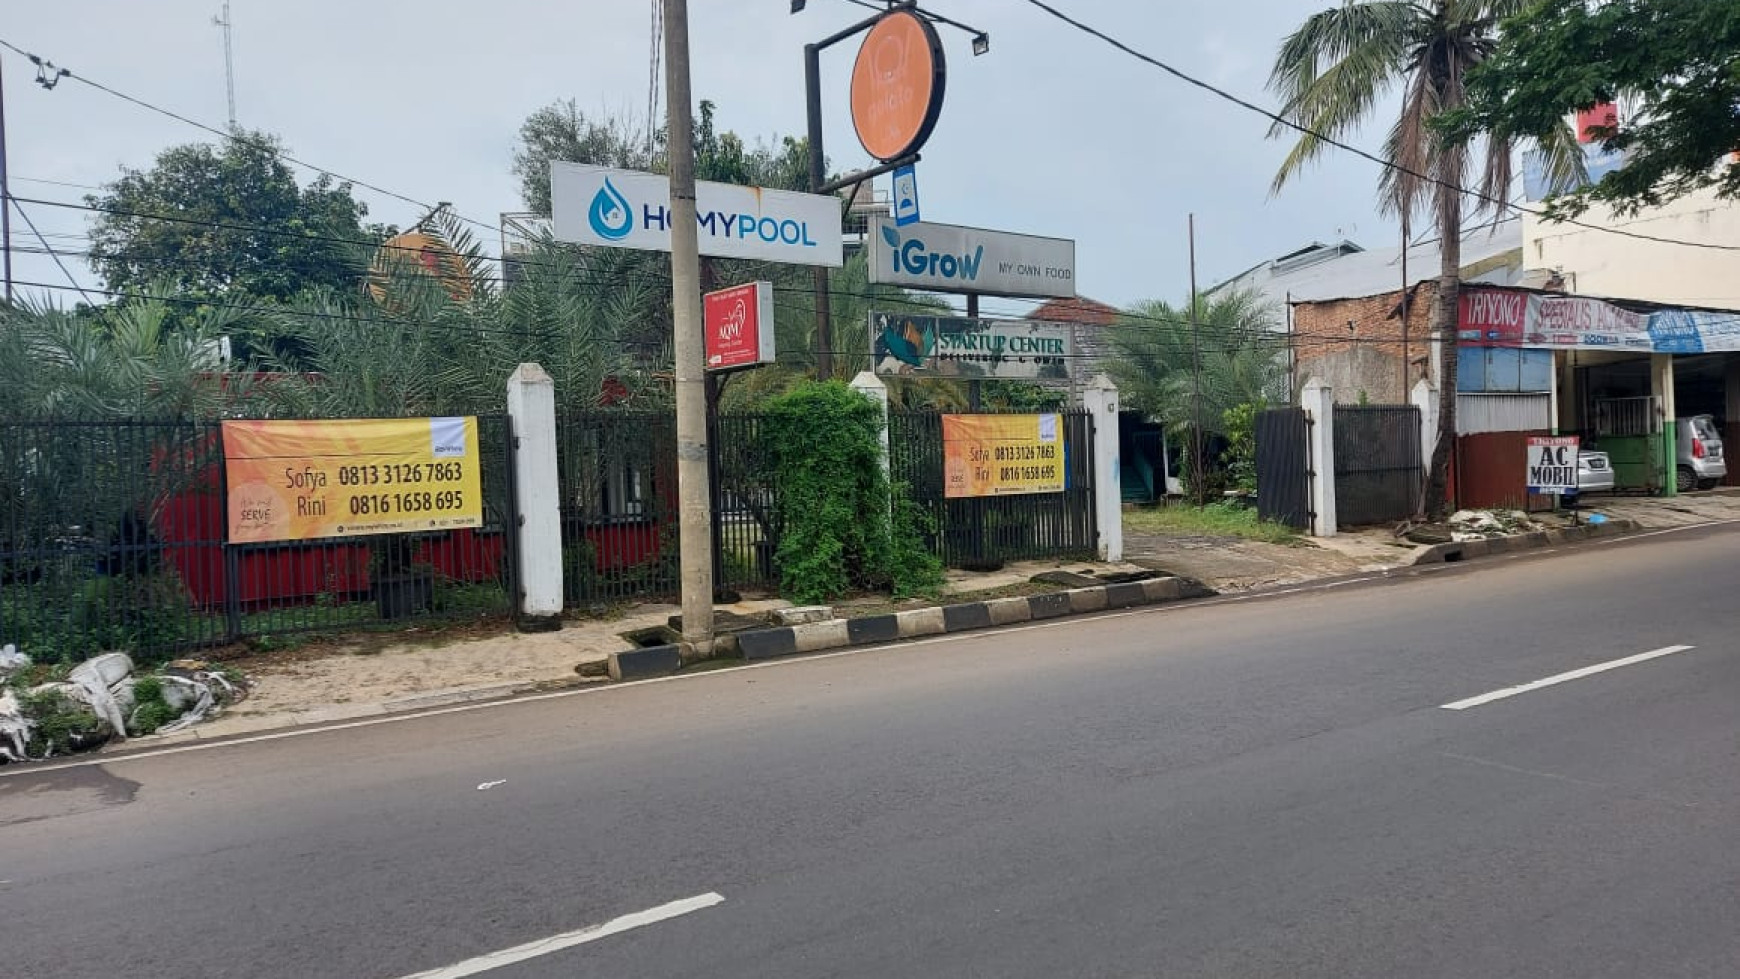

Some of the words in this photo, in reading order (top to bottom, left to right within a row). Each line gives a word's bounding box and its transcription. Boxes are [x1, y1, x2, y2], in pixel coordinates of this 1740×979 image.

[643, 203, 817, 246] HMYPOOL
[998, 261, 1014, 274] MY
[1017, 264, 1041, 276] OWN
[1045, 266, 1071, 280] FOOD
[939, 332, 1007, 353] STARTUP
[1009, 336, 1065, 355] CENTER
[995, 446, 1014, 462] 0813
[1540, 446, 1568, 466] AC
[285, 467, 327, 492] Sofya
[339, 465, 379, 486] 0813
[383, 464, 422, 484] 3126
[425, 462, 462, 481] 7863
[1530, 466, 1575, 486] MOBIL
[297, 496, 326, 517] Rini
[350, 495, 389, 515] 0816
[396, 493, 431, 512] 1658
[436, 491, 463, 510] 695
[241, 509, 271, 521] SERVE
